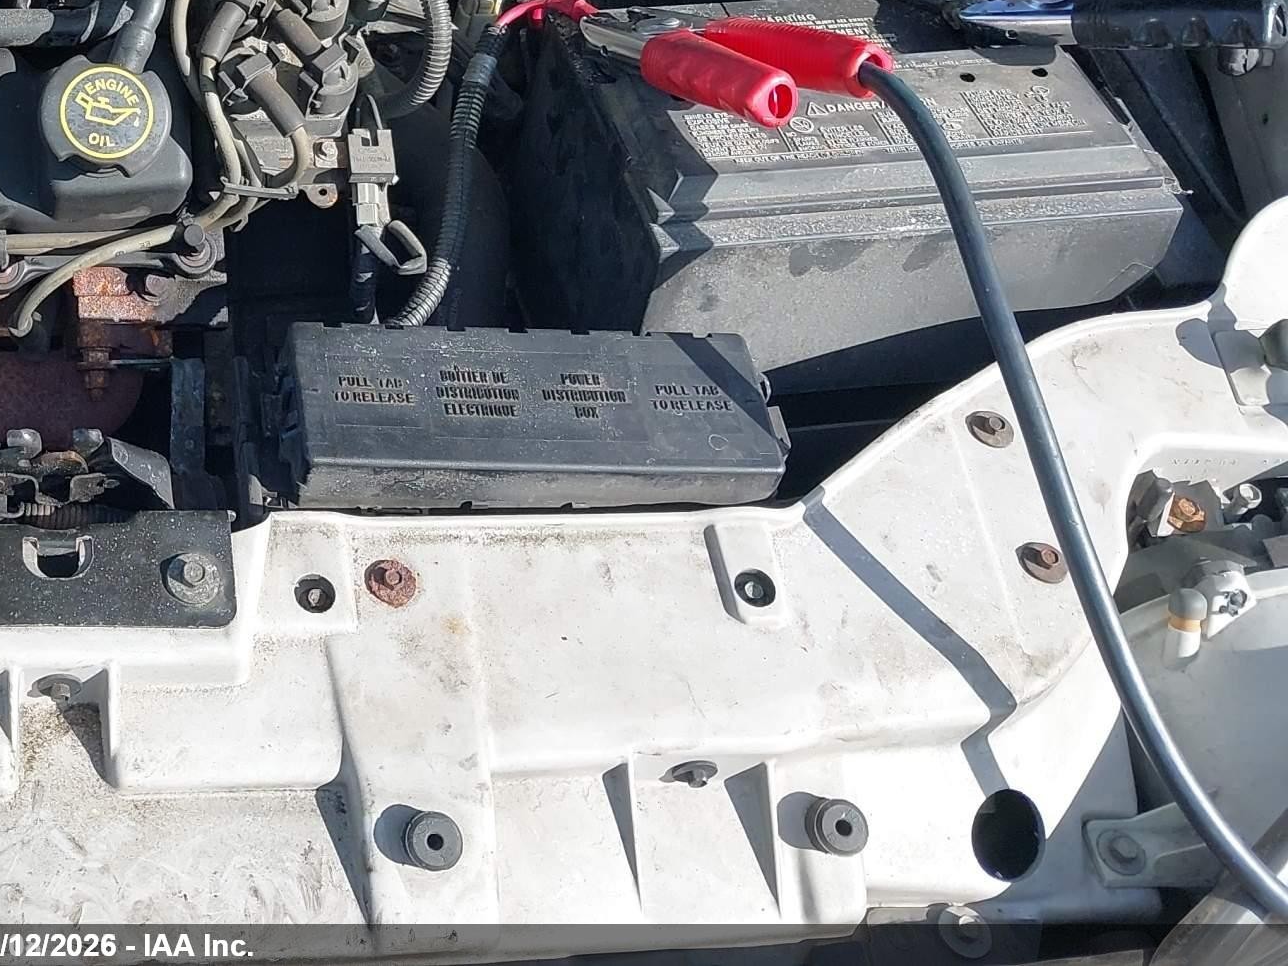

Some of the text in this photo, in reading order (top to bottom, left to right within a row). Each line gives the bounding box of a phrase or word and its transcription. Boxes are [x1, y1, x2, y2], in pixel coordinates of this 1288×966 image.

[84, 79, 140, 107] ENGINE
[88, 132, 116, 147] OIL
[337, 376, 372, 388] PULL
[561, 373, 601, 386] POWER
[333, 391, 414, 404] TO RELEASE
[436, 386, 520, 401] DISTRIBUTION
[542, 389, 627, 404] DISTRIBUTION
[655, 385, 719, 397] PULL TAB
[652, 399, 733, 412] TO RELEASE
[574, 406, 600, 419] BOX
